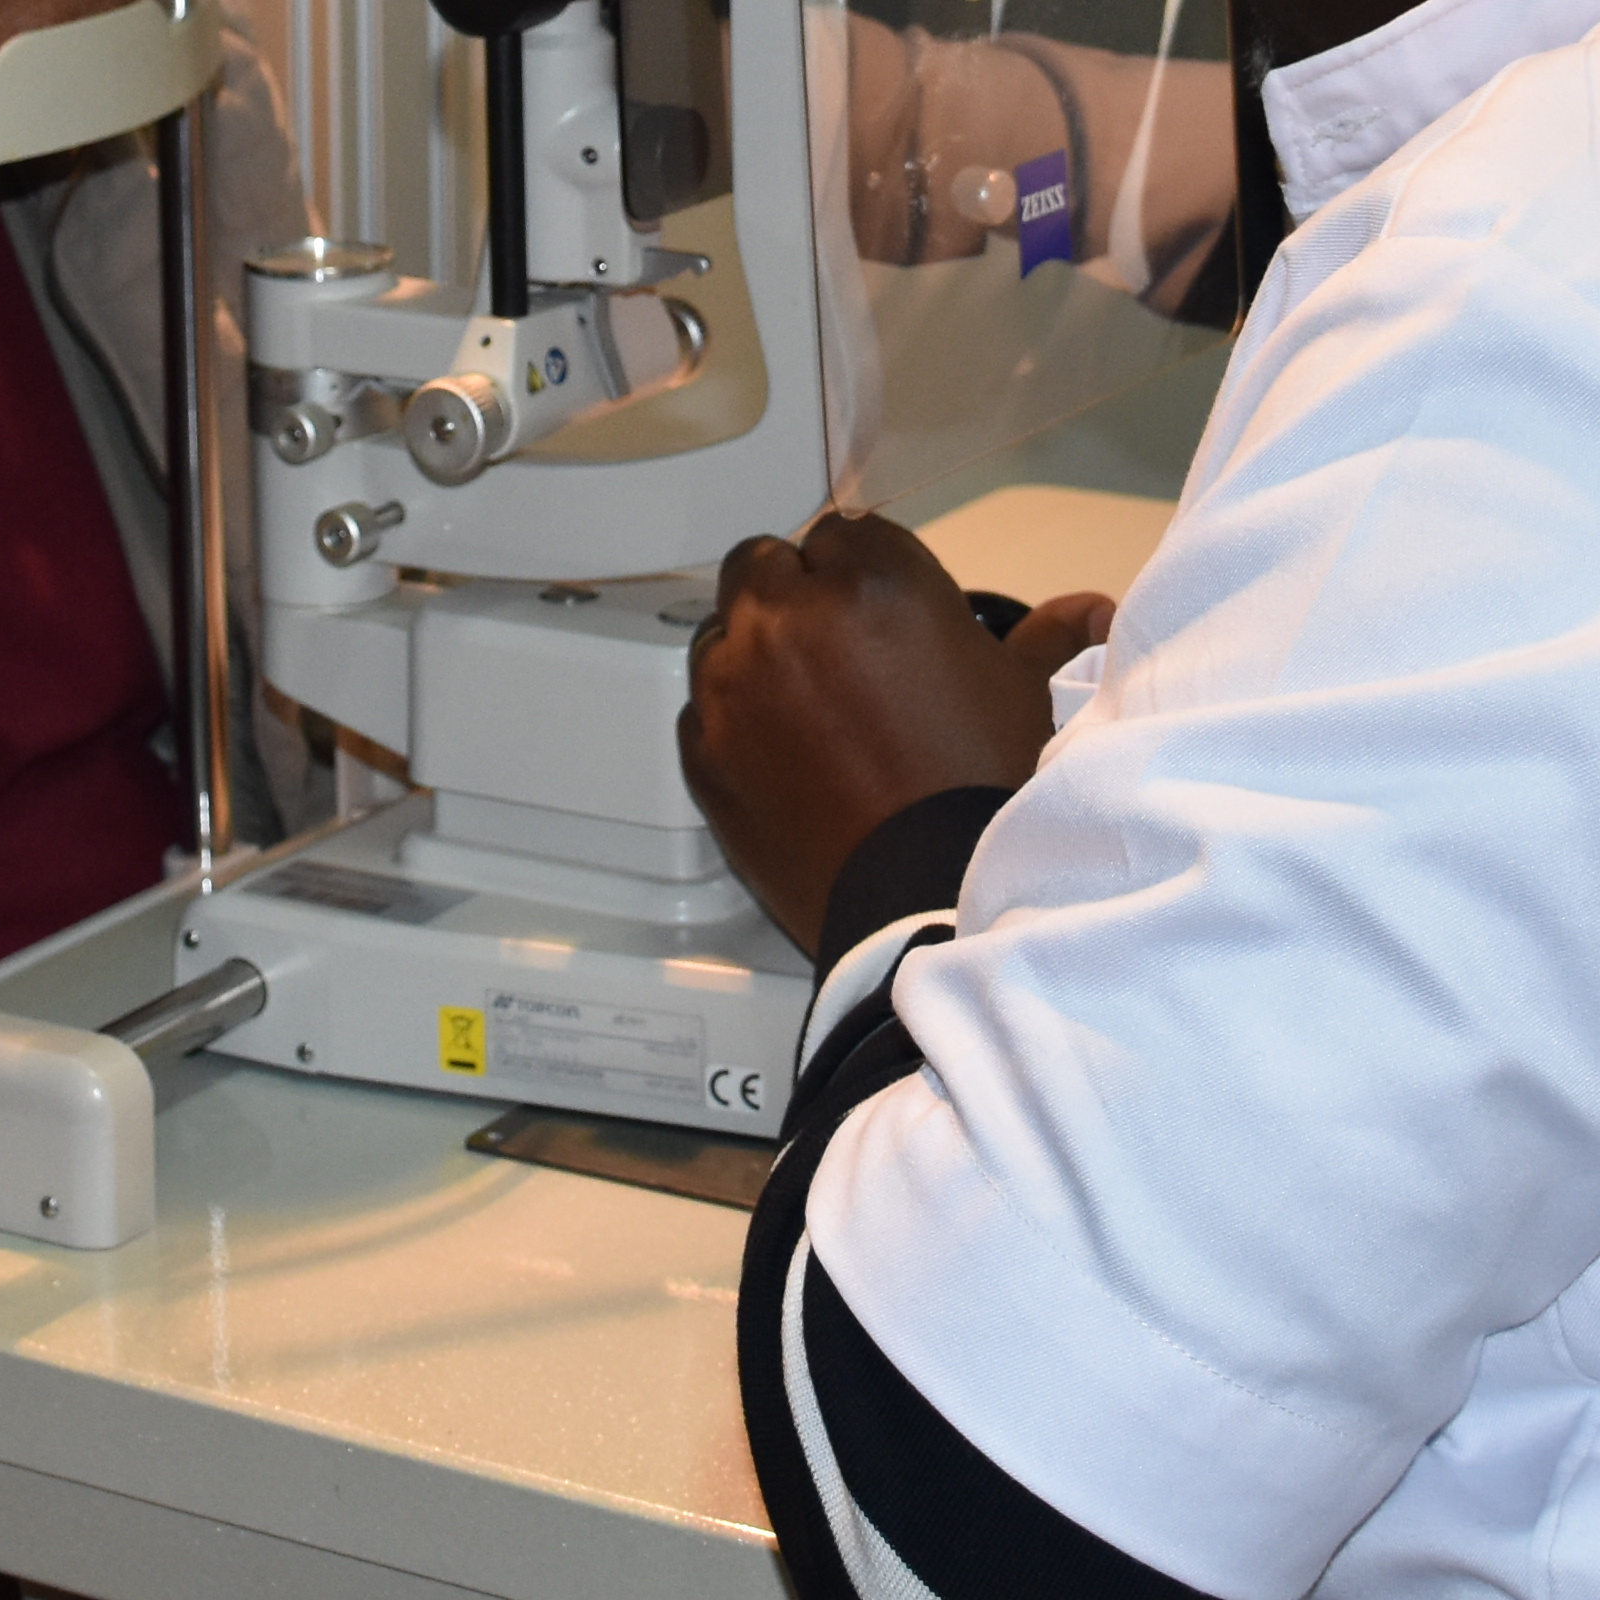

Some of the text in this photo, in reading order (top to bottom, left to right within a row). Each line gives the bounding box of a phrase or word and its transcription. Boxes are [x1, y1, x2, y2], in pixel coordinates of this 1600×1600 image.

[1021, 183, 1065, 222] ZEISS
[517, 999, 581, 1019] TOPCON
[709, 1069, 760, 1110] CE
